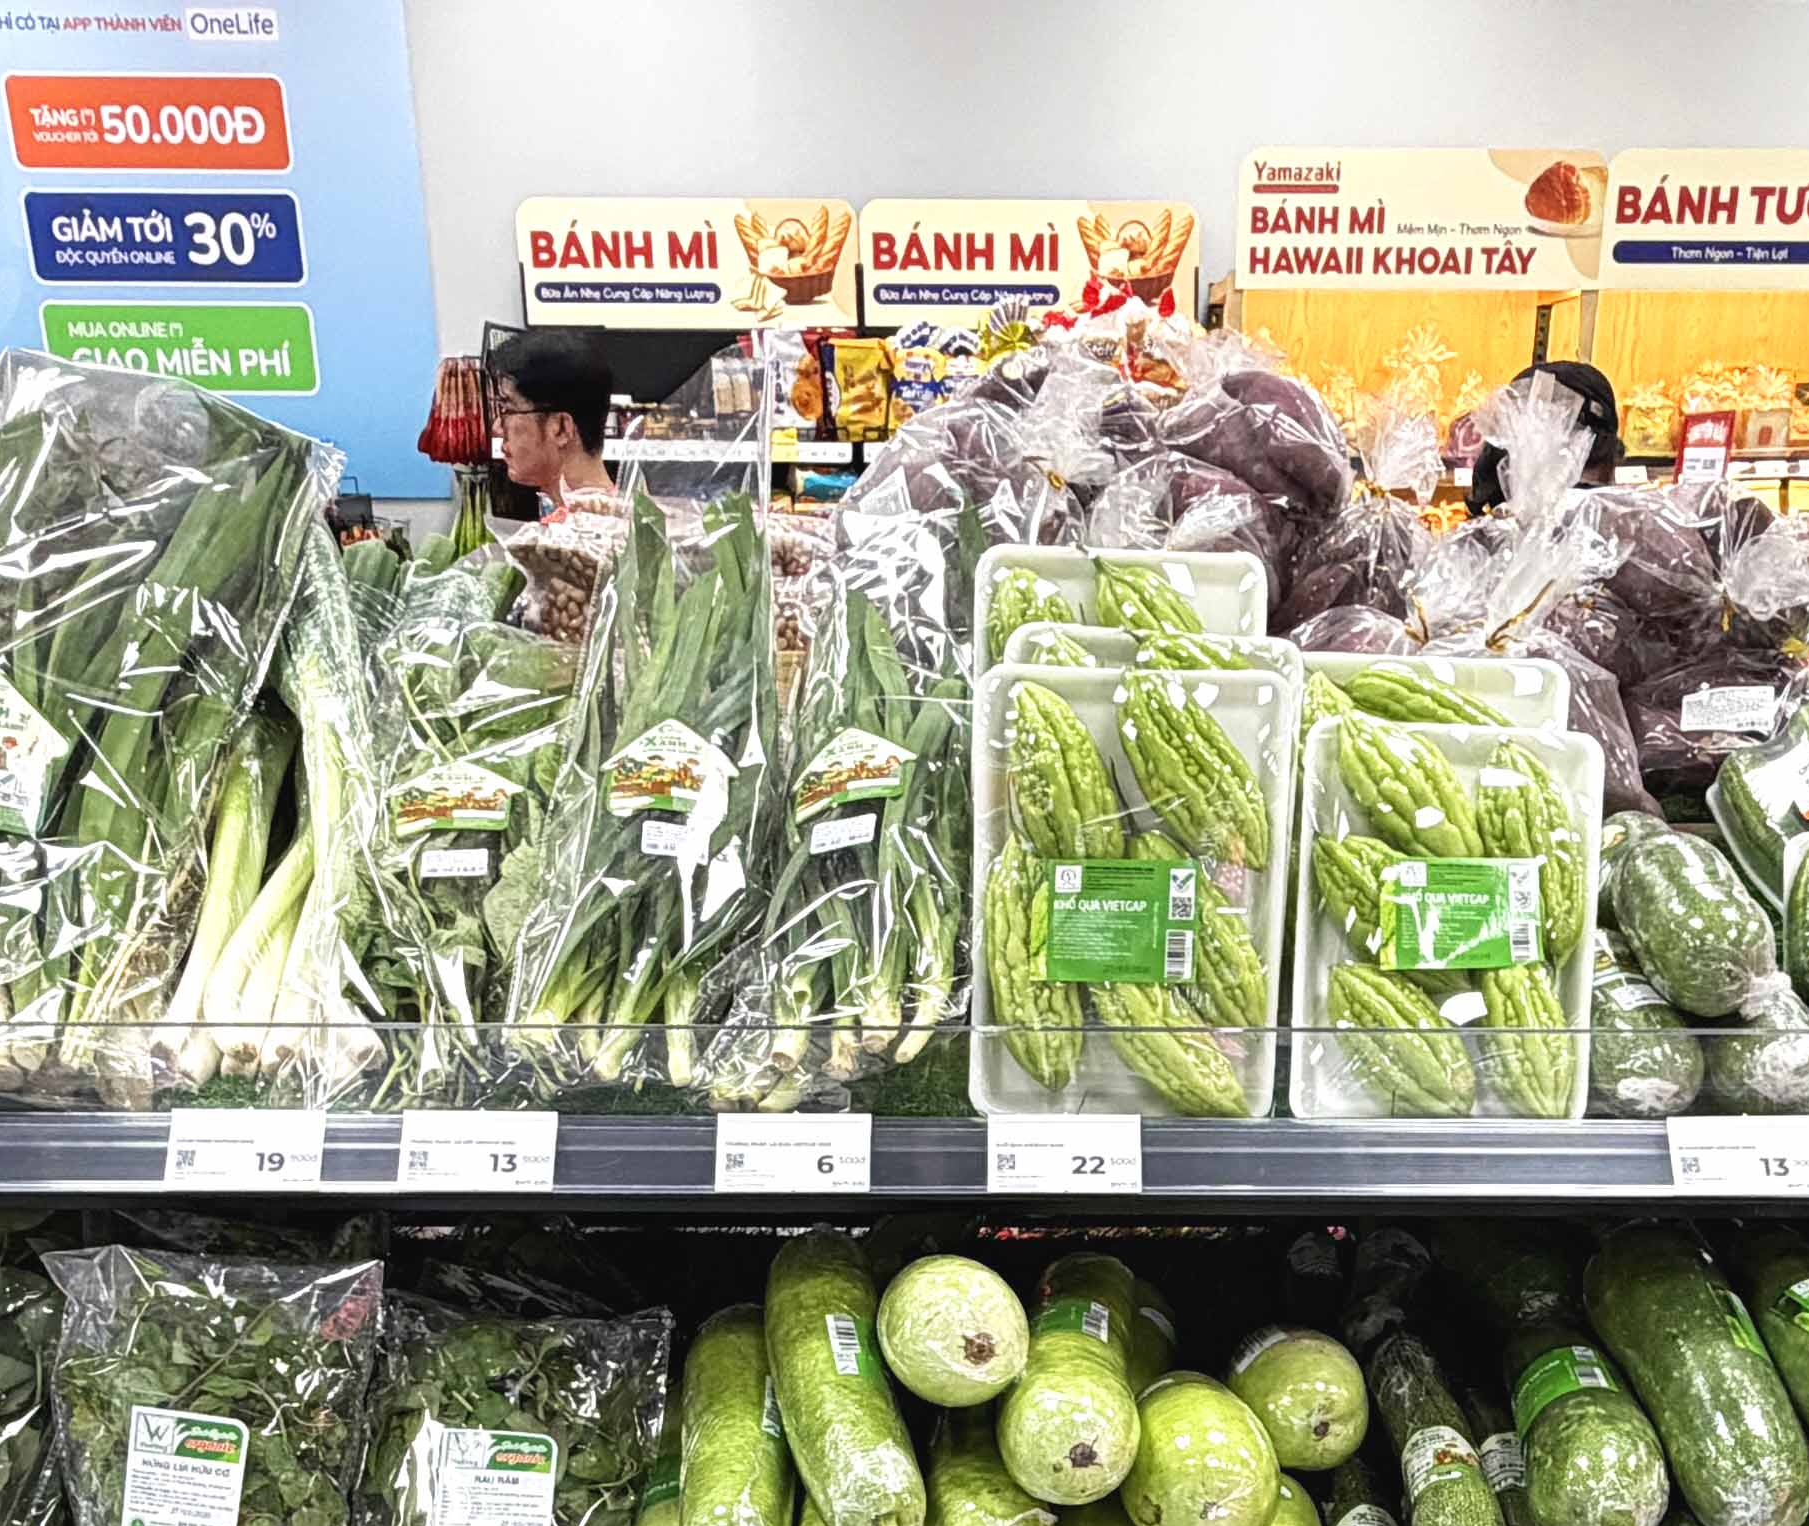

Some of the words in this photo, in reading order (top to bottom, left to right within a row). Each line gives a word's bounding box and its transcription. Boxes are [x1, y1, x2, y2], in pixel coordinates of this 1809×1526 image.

[63, 18, 91, 30] APP
[94, 14, 145, 31] THÀNH
[151, 15, 182, 31] VIÊN
[190, 13, 274, 35] OneLife
[29, 105, 79, 128] TẶNG
[99, 104, 266, 145] 50.000Đ
[1253, 160, 1342, 183] Yamazaki
[1615, 174, 1738, 225] BÁNH
[52, 209, 123, 243] GIẢM
[126, 209, 173, 243] TỚI
[1251, 196, 1340, 235] BÁNH
[1348, 197, 1386, 235] MÌ
[184, 211, 277, 266] 30%
[529, 219, 654, 270] BÁNH
[669, 219, 719, 270] MÌ
[872, 219, 994, 271] BÁNH
[1009, 221, 1059, 272] MÌ
[131, 251, 176, 265] ONLINE
[1249, 246, 1364, 275] HAWAII
[1373, 245, 1473, 275] KHOAI
[1480, 239, 1538, 275] TÂY
[68, 322, 107, 338] MUA
[111, 322, 168, 338] ONLINE
[156, 337, 232, 377] MIỄN
[241, 340, 291, 377] PHÍ
[1078, 900, 1100, 912] QUA
[1101, 900, 1148, 912] VIETGAP
[255, 1152, 286, 1172] 19
[489, 1153, 518, 1173] 13
[816, 1154, 835, 1174] 6
[1071, 1155, 1106, 1175] 22
[1758, 1157, 1790, 1177] 13
